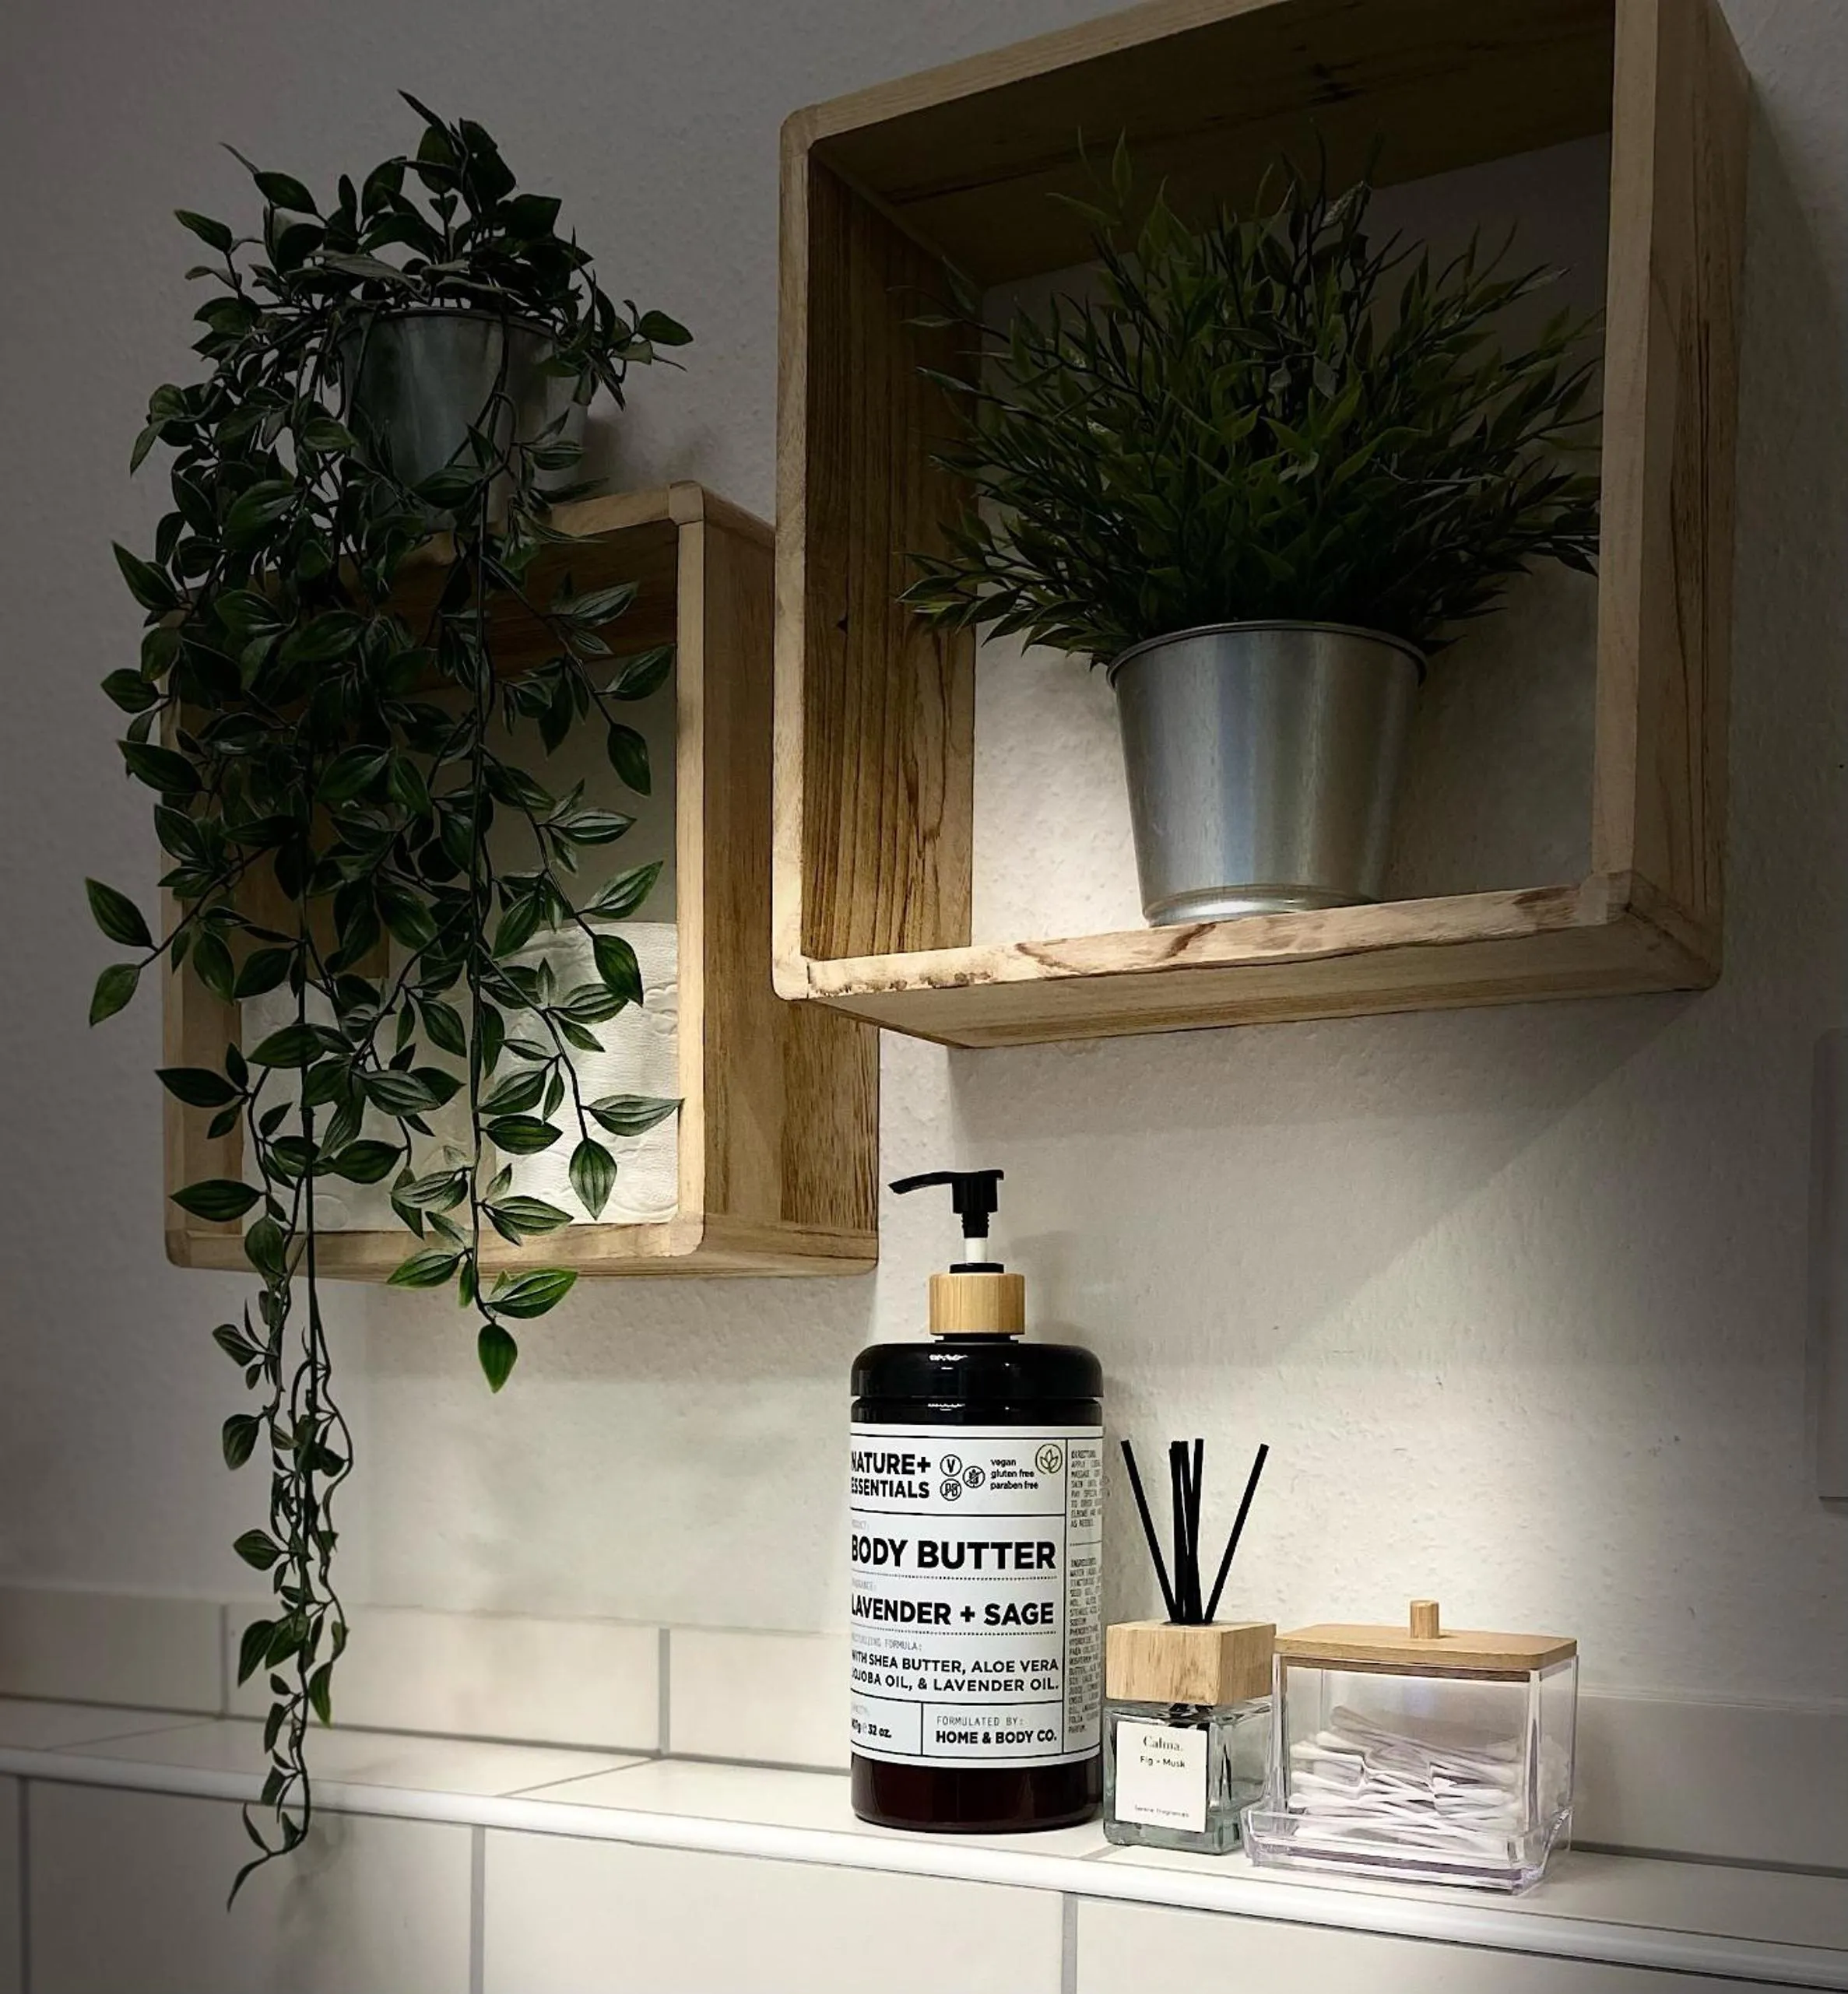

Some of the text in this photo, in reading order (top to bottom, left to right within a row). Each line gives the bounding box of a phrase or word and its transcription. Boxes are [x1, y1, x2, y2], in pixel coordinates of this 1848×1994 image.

[851, 1450, 931, 1476] NATURE+
[990, 1459, 1017, 1468] vegan
[990, 1469, 1035, 1479] gluten free
[851, 1476, 930, 1499] ESSENTIALS
[990, 1481, 1039, 1490] paraben free
[852, 1534, 1056, 1570] BODY BUTTER
[852, 1592, 1054, 1625] LAVENDER + SAGE
[869, 1653, 898, 1669] SHEA
[902, 1658, 966, 1675] BUTTER,
[971, 1659, 1015, 1673] ALOE
[1020, 1658, 1059, 1672] VERA
[885, 1674, 912, 1691] OIL,
[917, 1676, 928, 1690] &
[933, 1677, 1024, 1692] LAVENDER
[1029, 1676, 1059, 1690] OIL.
[936, 1715, 1024, 1726] FORMULATED BY:
[868, 1723, 877, 1736] 32
[878, 1727, 892, 1738] oz.
[936, 1730, 978, 1744] HOME
[981, 1732, 992, 1744] &
[995, 1729, 1034, 1744] BODY
[1036, 1729, 1057, 1743] CO.
[1140, 1755, 1154, 1766] Fig
[1162, 1758, 1186, 1768] Musk
